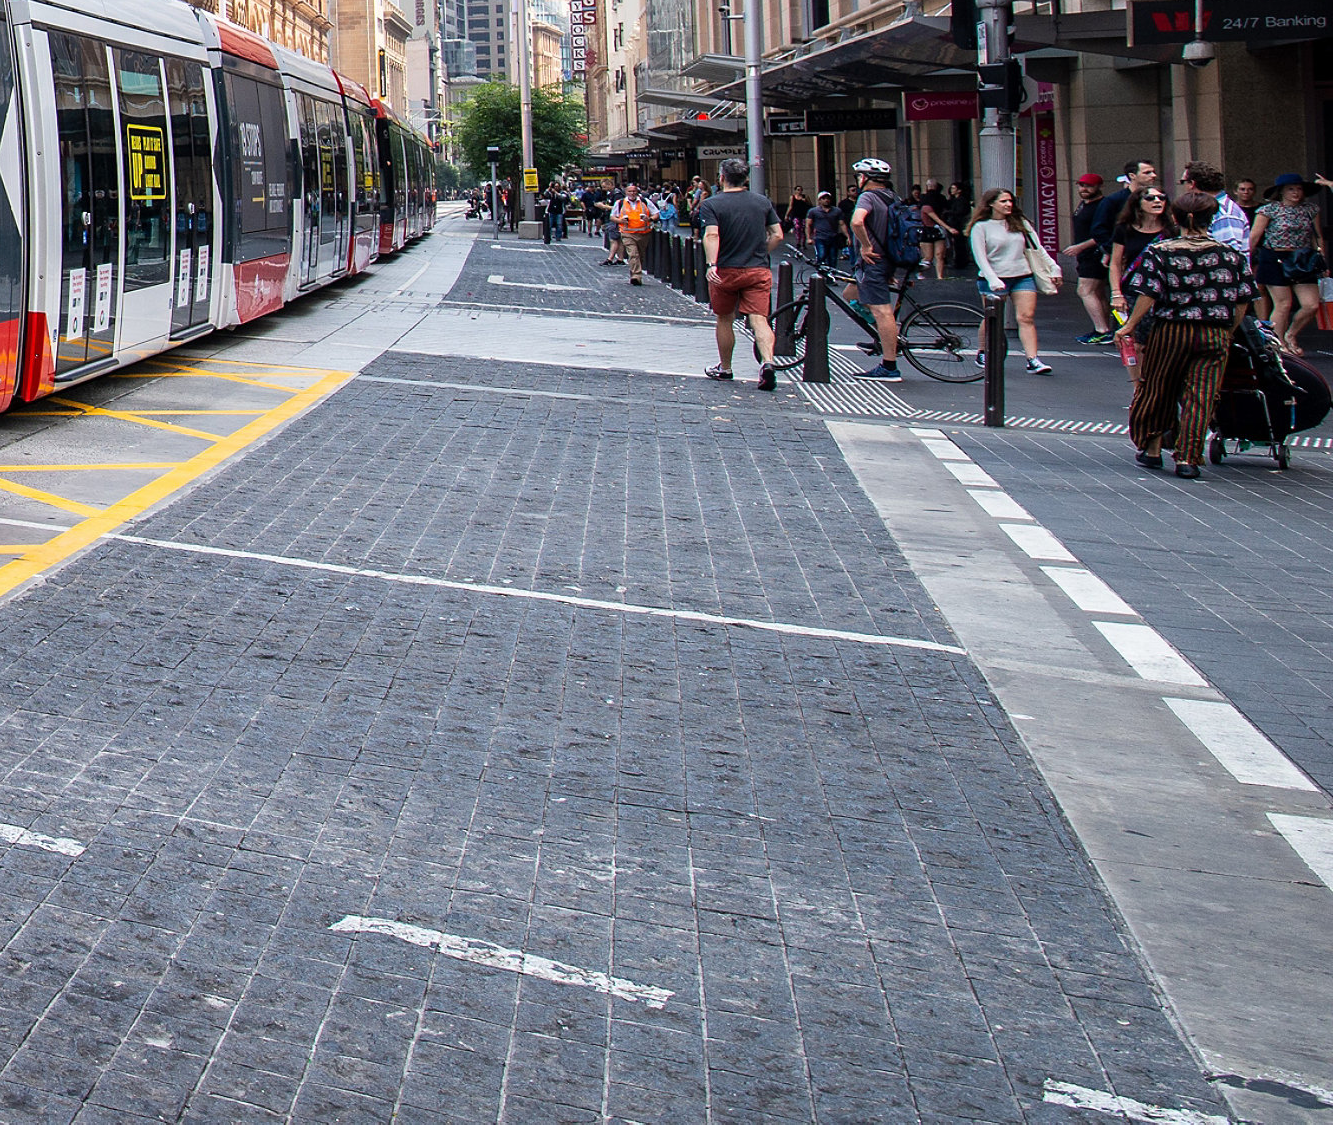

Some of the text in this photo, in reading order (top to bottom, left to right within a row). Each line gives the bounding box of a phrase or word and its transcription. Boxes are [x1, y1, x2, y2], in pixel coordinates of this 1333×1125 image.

[1222, 14, 1327, 30] 24/7 Banking
[813, 111, 893, 122] WORKSHOP
[702, 148, 746, 157] CRUMPLE
[131, 152, 144, 189] UP
[1041, 181, 1056, 253] PHARMACY
